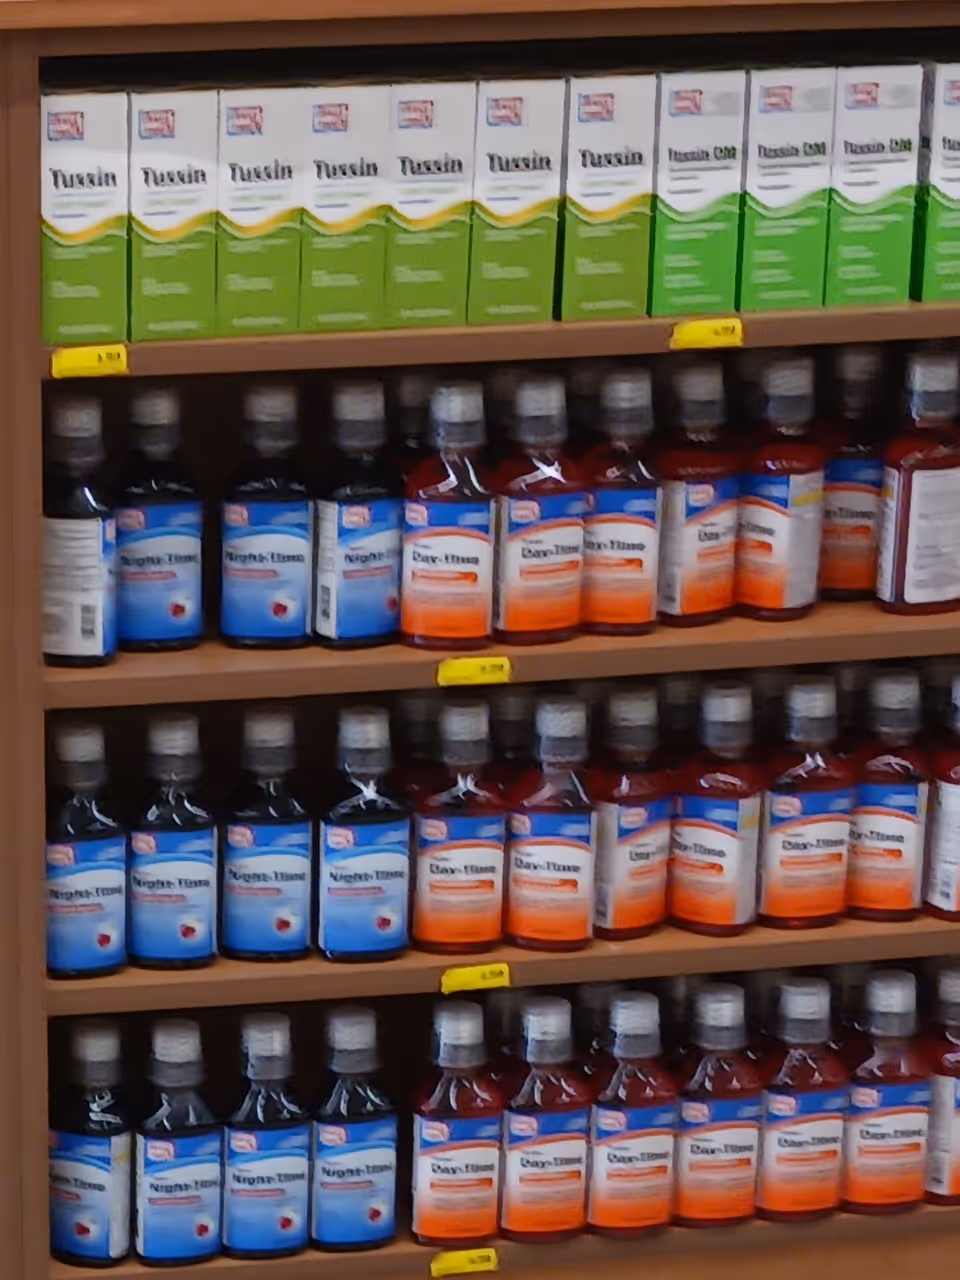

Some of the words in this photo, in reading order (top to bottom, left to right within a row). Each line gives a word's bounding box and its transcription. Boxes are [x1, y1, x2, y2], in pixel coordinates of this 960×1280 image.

[397, 153, 463, 176] Tussin
[487, 149, 552, 172] Tussin
[579, 145, 644, 168] Tussin
[49, 166, 117, 190] Tussin
[141, 164, 207, 187] Tussin
[228, 159, 293, 184] Tussin
[313, 157, 378, 180] Tussin
